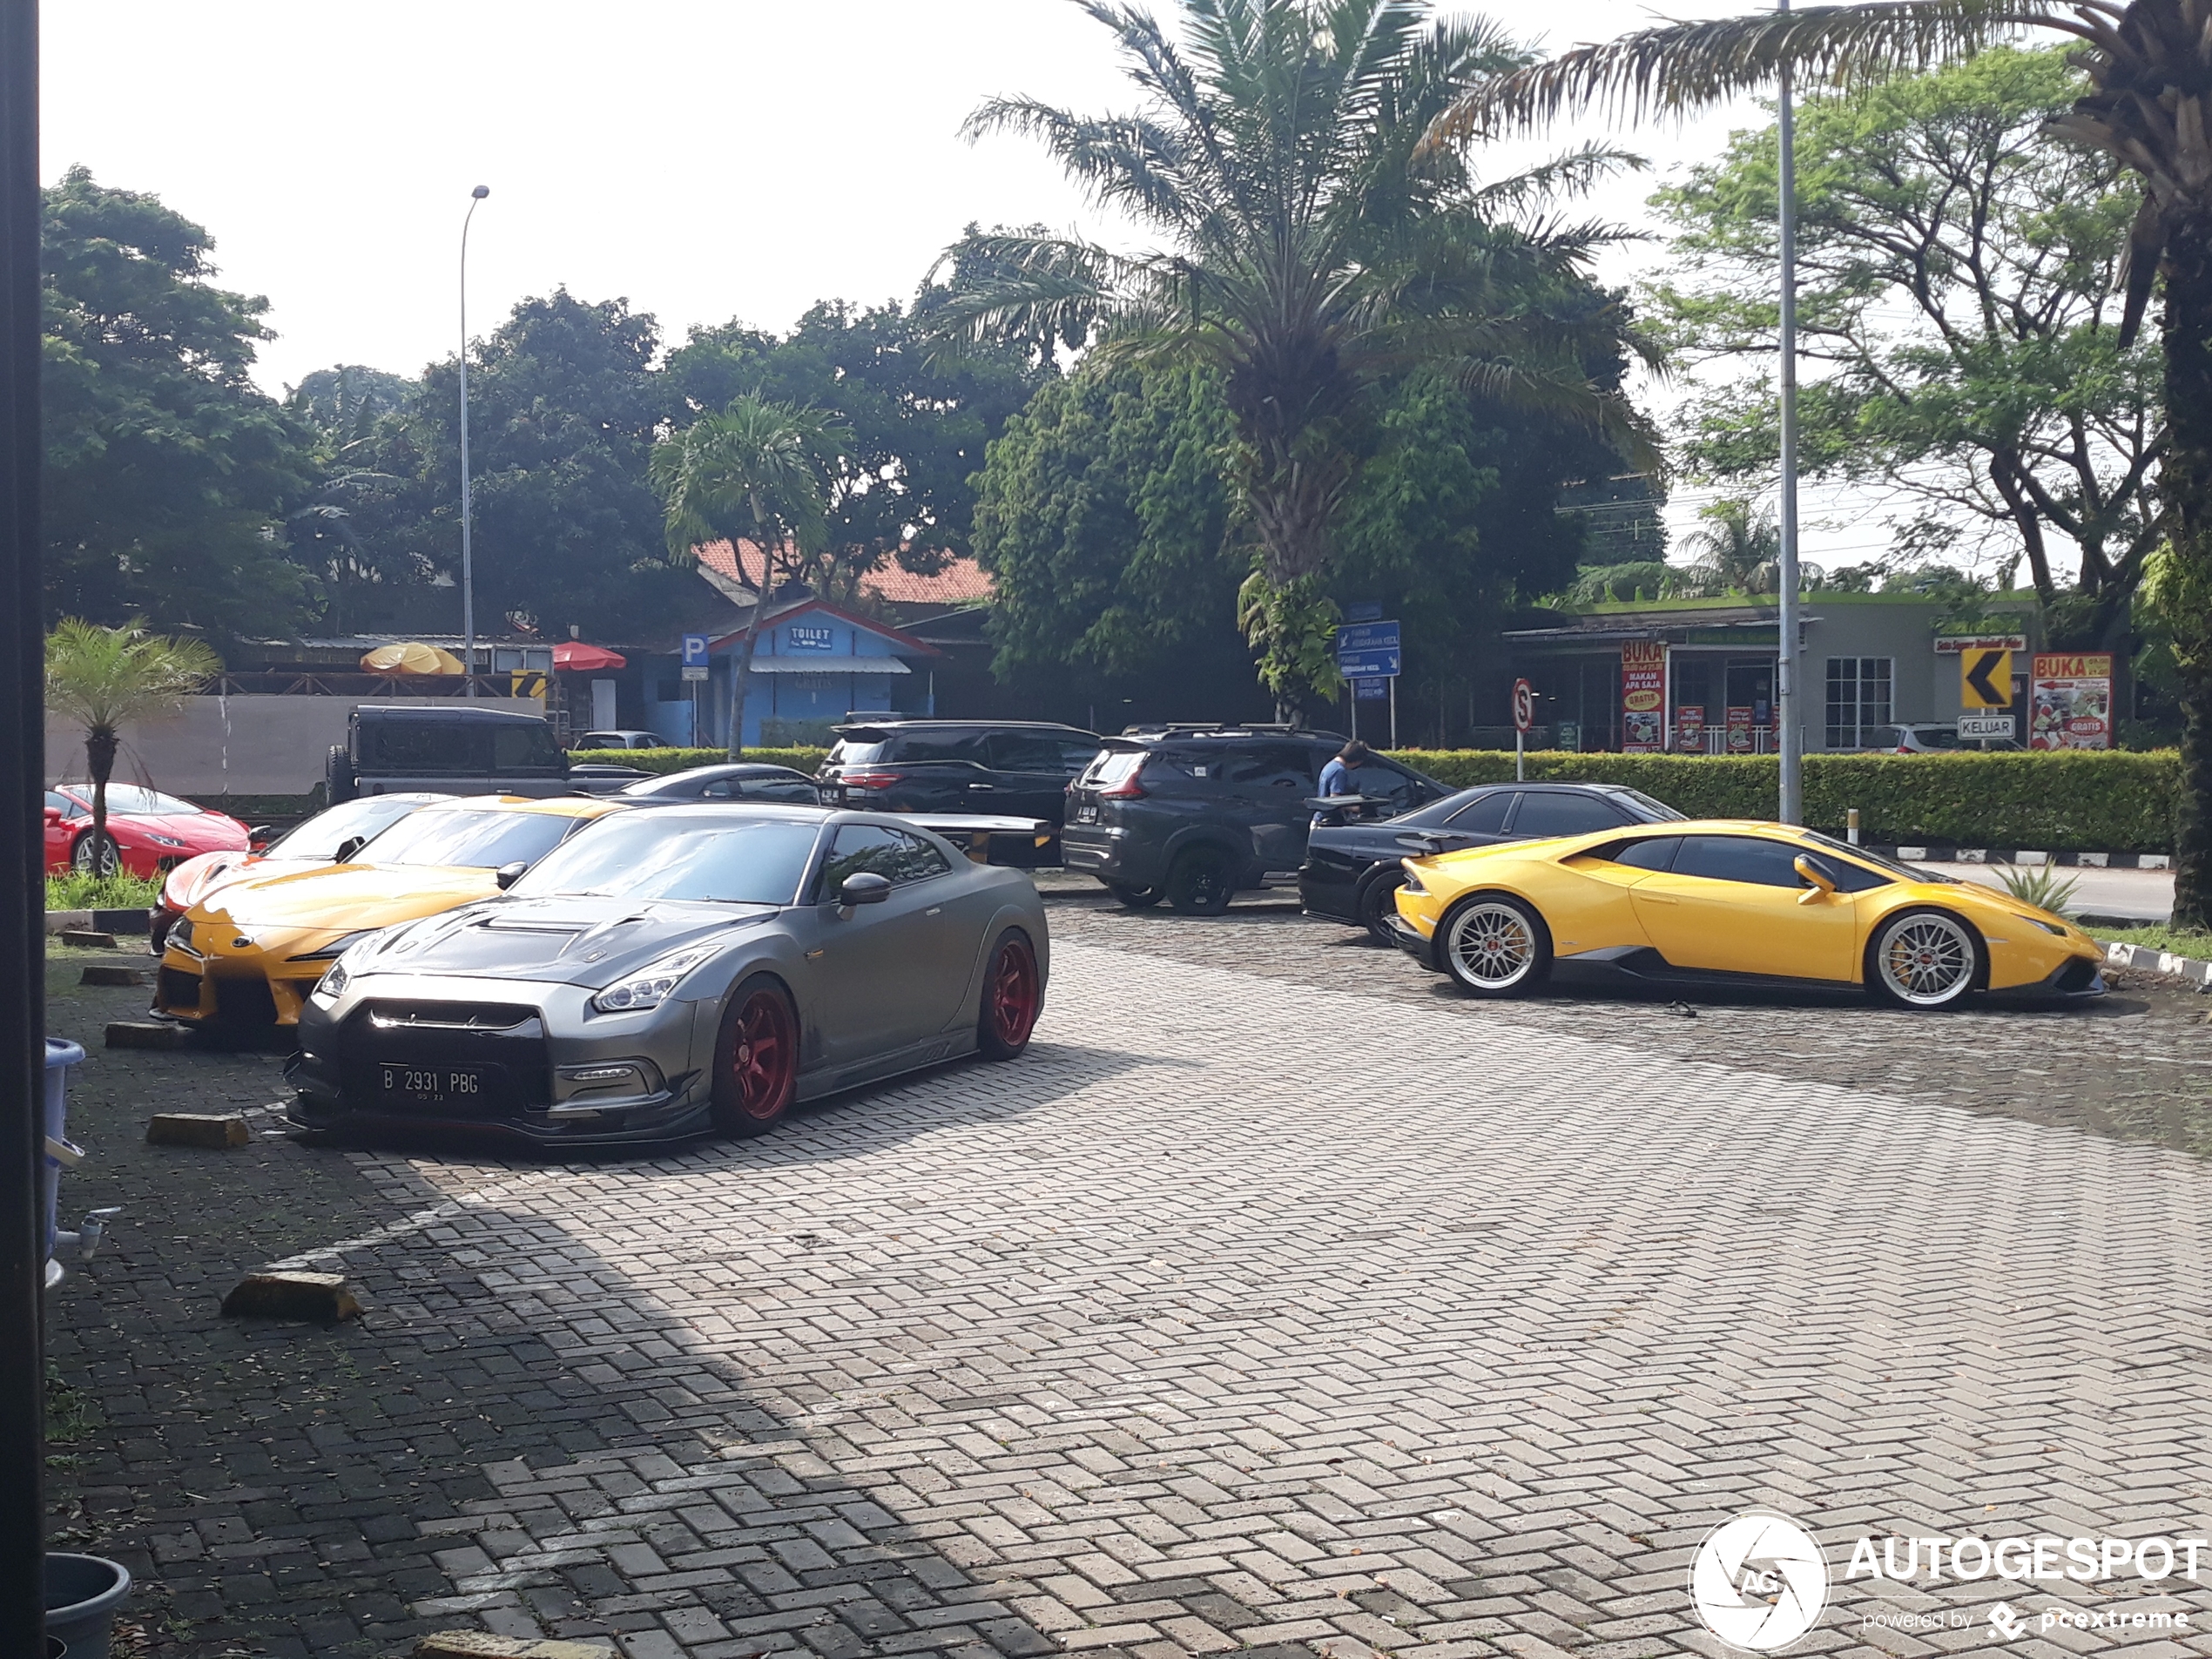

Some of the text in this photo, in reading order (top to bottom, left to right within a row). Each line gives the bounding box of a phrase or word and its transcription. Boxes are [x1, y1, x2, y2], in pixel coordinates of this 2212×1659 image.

[791, 628, 829, 640] TOILET
[685, 637, 705, 663] P
[1622, 641, 1662, 662] BUKA
[2036, 658, 2087, 677] BUKA
[1629, 672, 1656, 681] MAKAN
[1641, 680, 1661, 689] SAJA
[1629, 693, 1656, 705] GRATIS
[1962, 721, 2011, 733] KELUAR
[2071, 721, 2101, 732] GRATIS
[384, 1069, 479, 1094] B 2931 PBG
